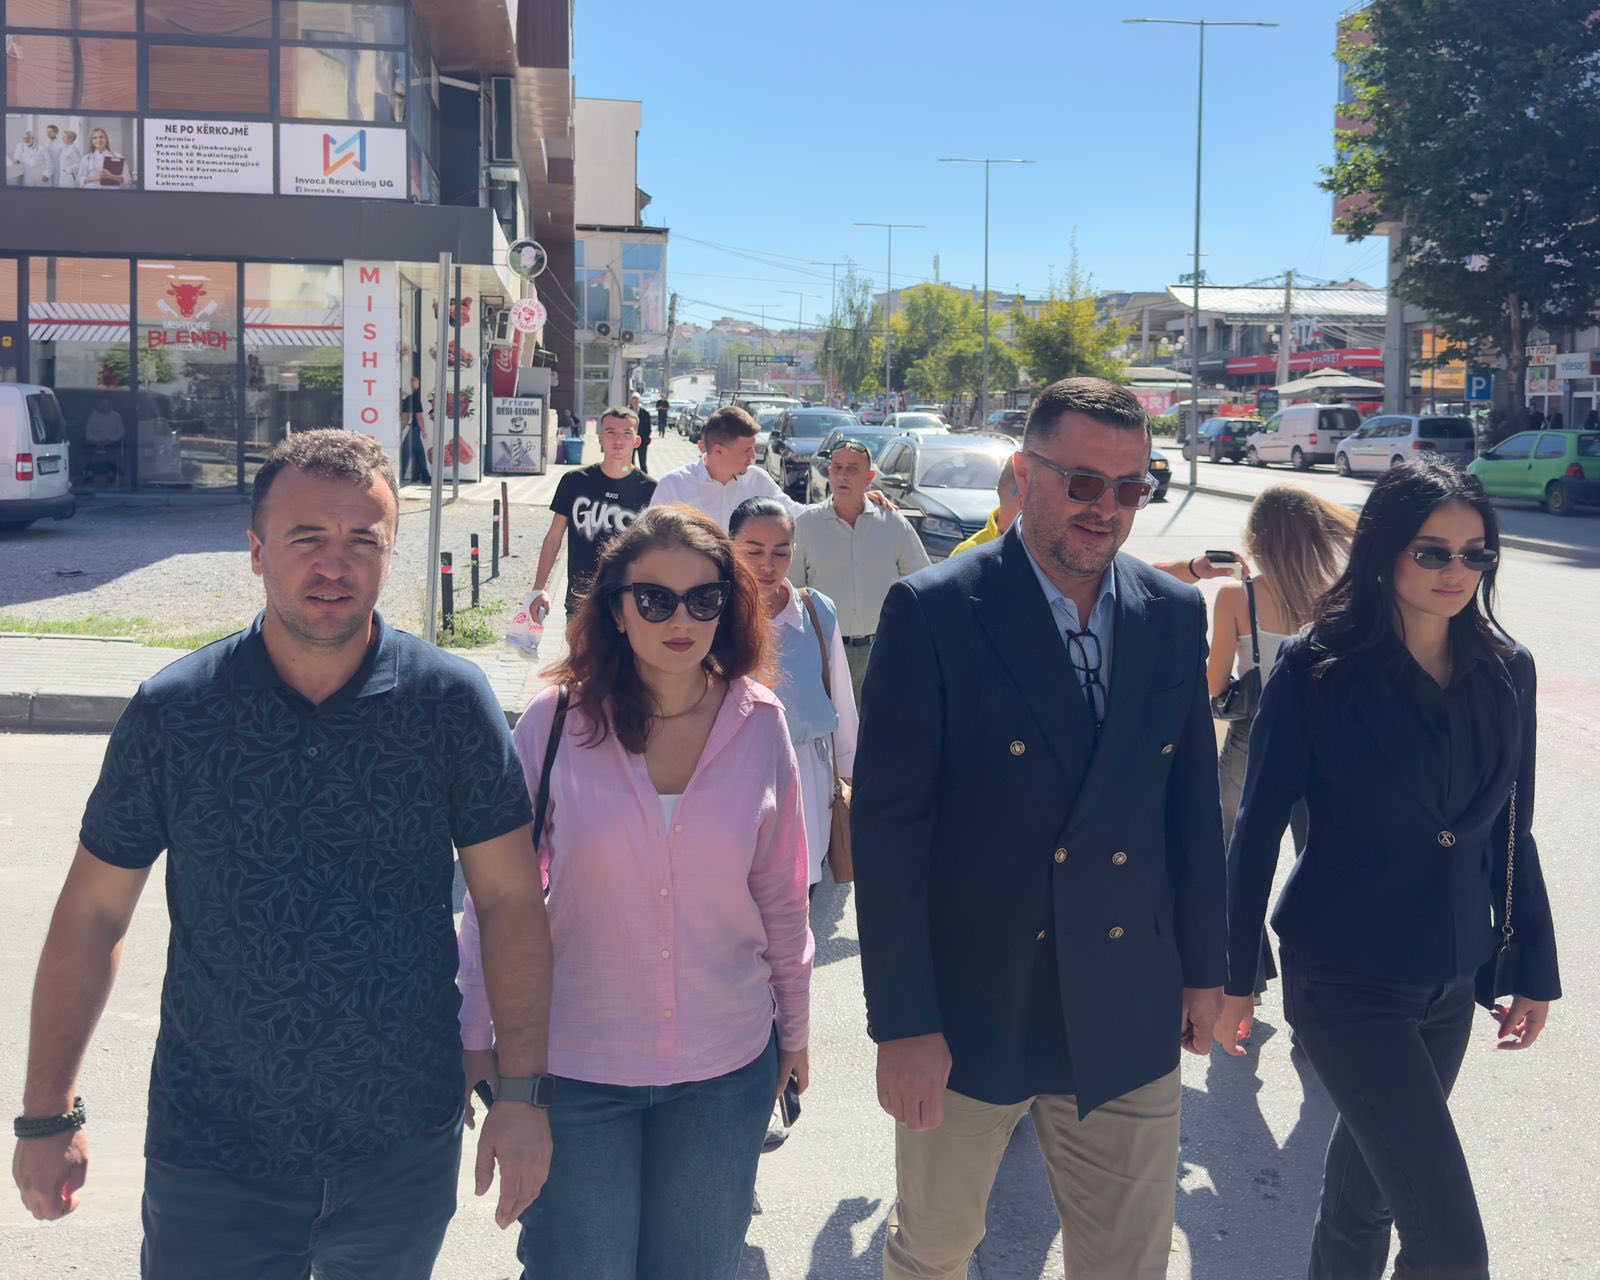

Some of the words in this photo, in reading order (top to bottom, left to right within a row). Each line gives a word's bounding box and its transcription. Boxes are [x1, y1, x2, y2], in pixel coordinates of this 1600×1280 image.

[165, 124, 177, 134] NE
[180, 125, 194, 134] PO
[197, 123, 249, 136] KËRKOJMË
[295, 176, 325, 185] Invoca
[329, 178, 377, 188] Recruiting
[147, 330, 227, 352] BLENDI
[359, 266, 380, 440] MISHTO
[1312, 353, 1341, 364] MARKET
[1471, 376, 1486, 398] P
[501, 398, 535, 407] Frizer
[496, 406, 540, 416] BESI-ELDONI
[572, 495, 638, 542] GUCC
